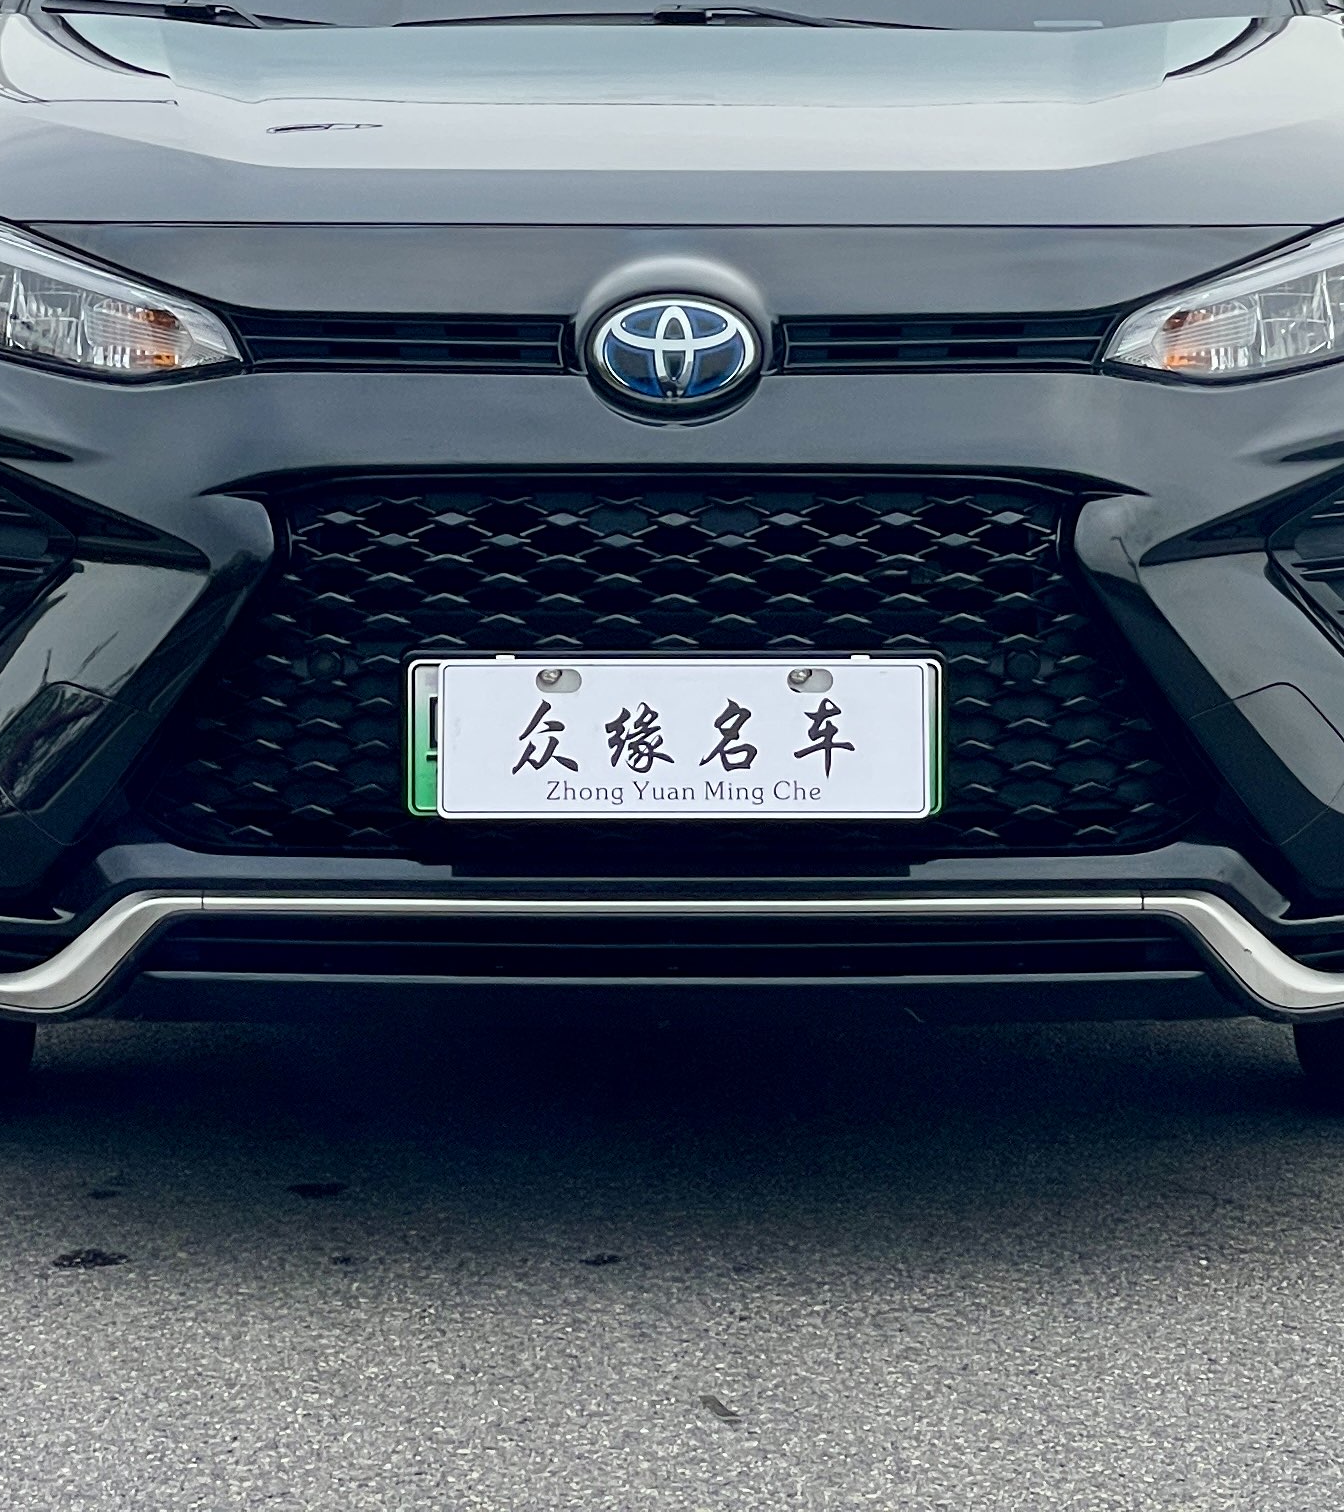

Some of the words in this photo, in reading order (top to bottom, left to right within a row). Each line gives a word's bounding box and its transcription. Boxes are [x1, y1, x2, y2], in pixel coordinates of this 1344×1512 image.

[511, 697, 856, 779] 众缘名车
[546, 780, 624, 806] Zhong
[633, 780, 696, 801] Yuan
[704, 780, 765, 806] Ming
[773, 780, 822, 801] Che
